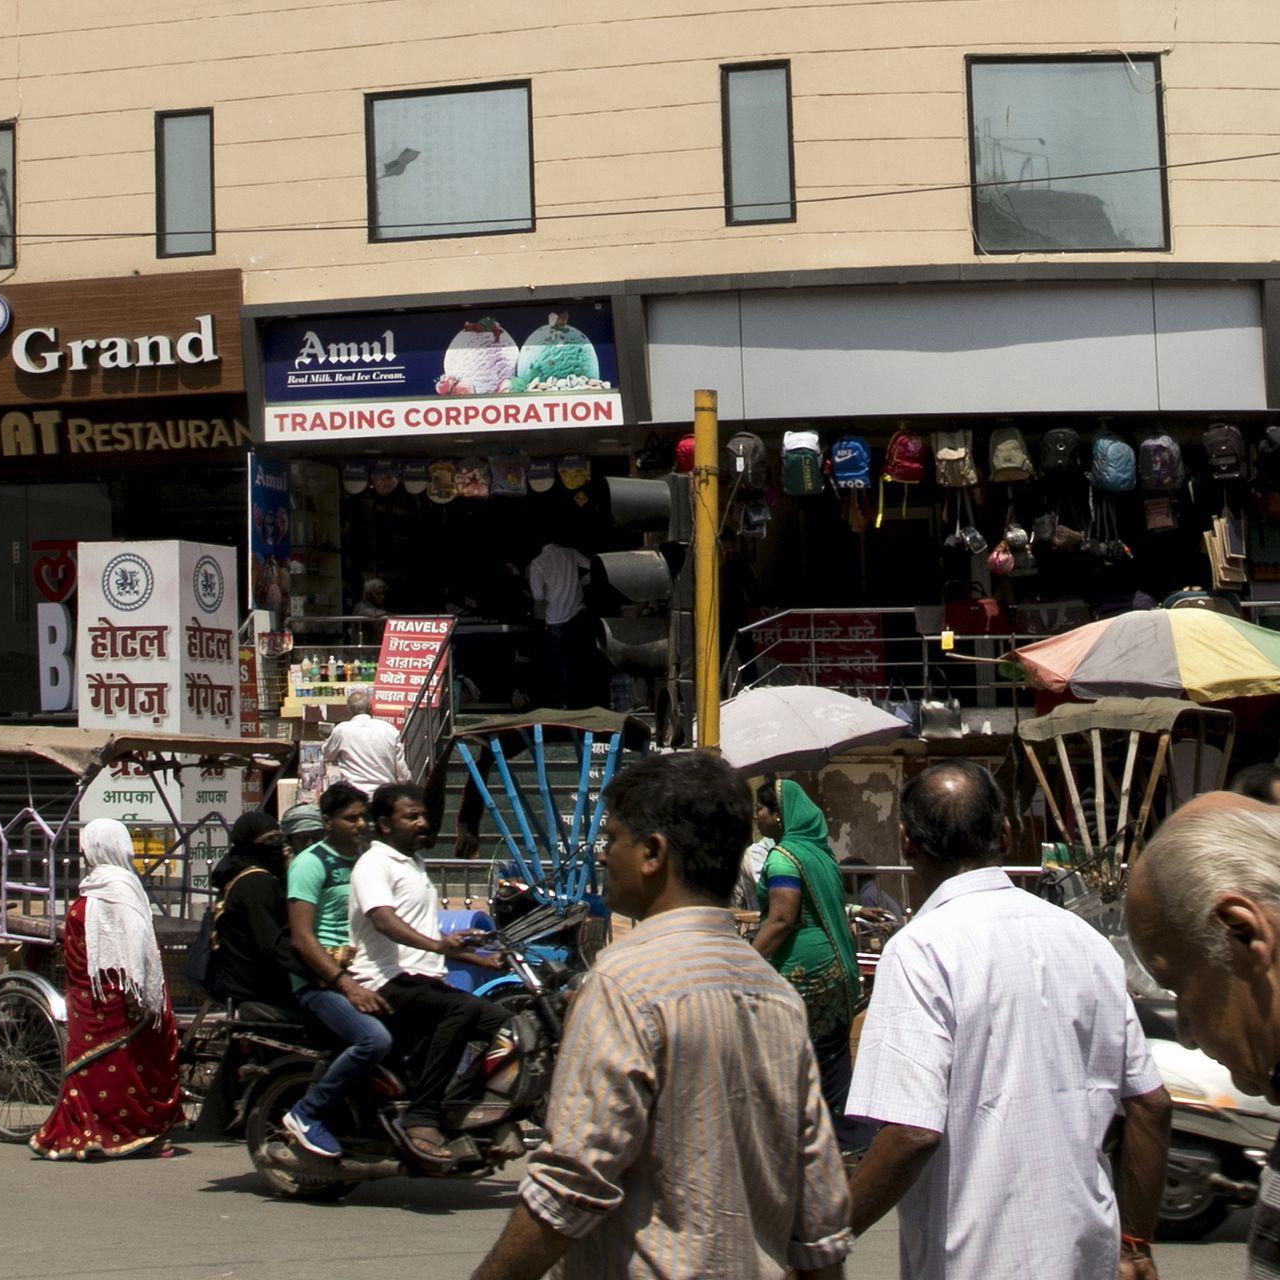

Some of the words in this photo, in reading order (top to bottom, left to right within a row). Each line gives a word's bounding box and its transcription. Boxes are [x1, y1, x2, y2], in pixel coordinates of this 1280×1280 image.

[11, 314, 221, 375] Grand
[293, 329, 399, 370] Amul
[286, 375, 310, 386] Real
[310, 373, 333, 385] Milk.
[334, 372, 355, 383] Real
[356, 371, 371, 382] Ice
[372, 370, 406, 381] Cream.
[274, 407, 396, 433] TRADING
[403, 400, 614, 428] CORPORATION
[254, 464, 288, 492] Amul
[87, 616, 169, 659] होटल
[185, 616, 233, 661] होटल
[388, 620, 448, 633] TRAVELS
[85, 673, 169, 725] गैंगेज़
[103, 790, 156, 805] आपका
[195, 790, 228, 804] आपका
